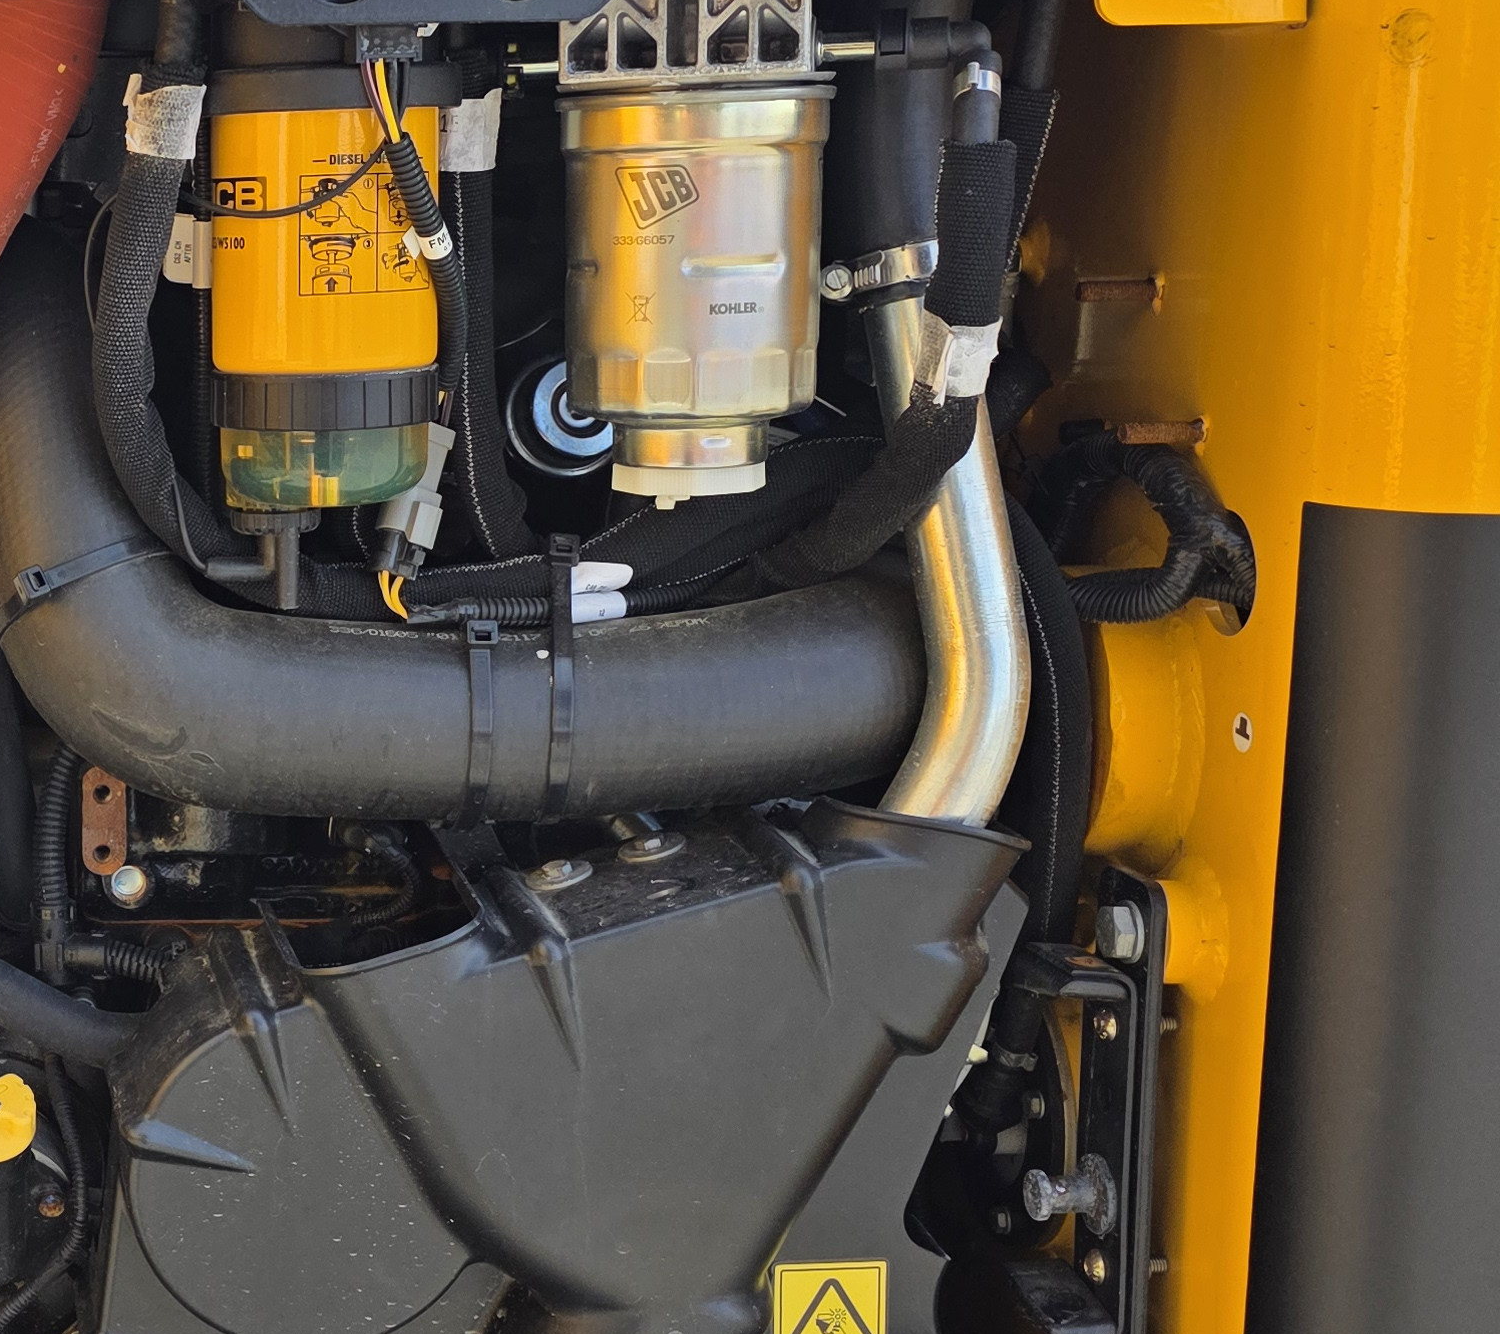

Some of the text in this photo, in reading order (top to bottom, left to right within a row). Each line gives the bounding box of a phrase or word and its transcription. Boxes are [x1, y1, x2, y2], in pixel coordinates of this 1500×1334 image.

[329, 153, 365, 165] DIESEL
[628, 170, 693, 221] JCB
[709, 302, 757, 315] KOHLER
